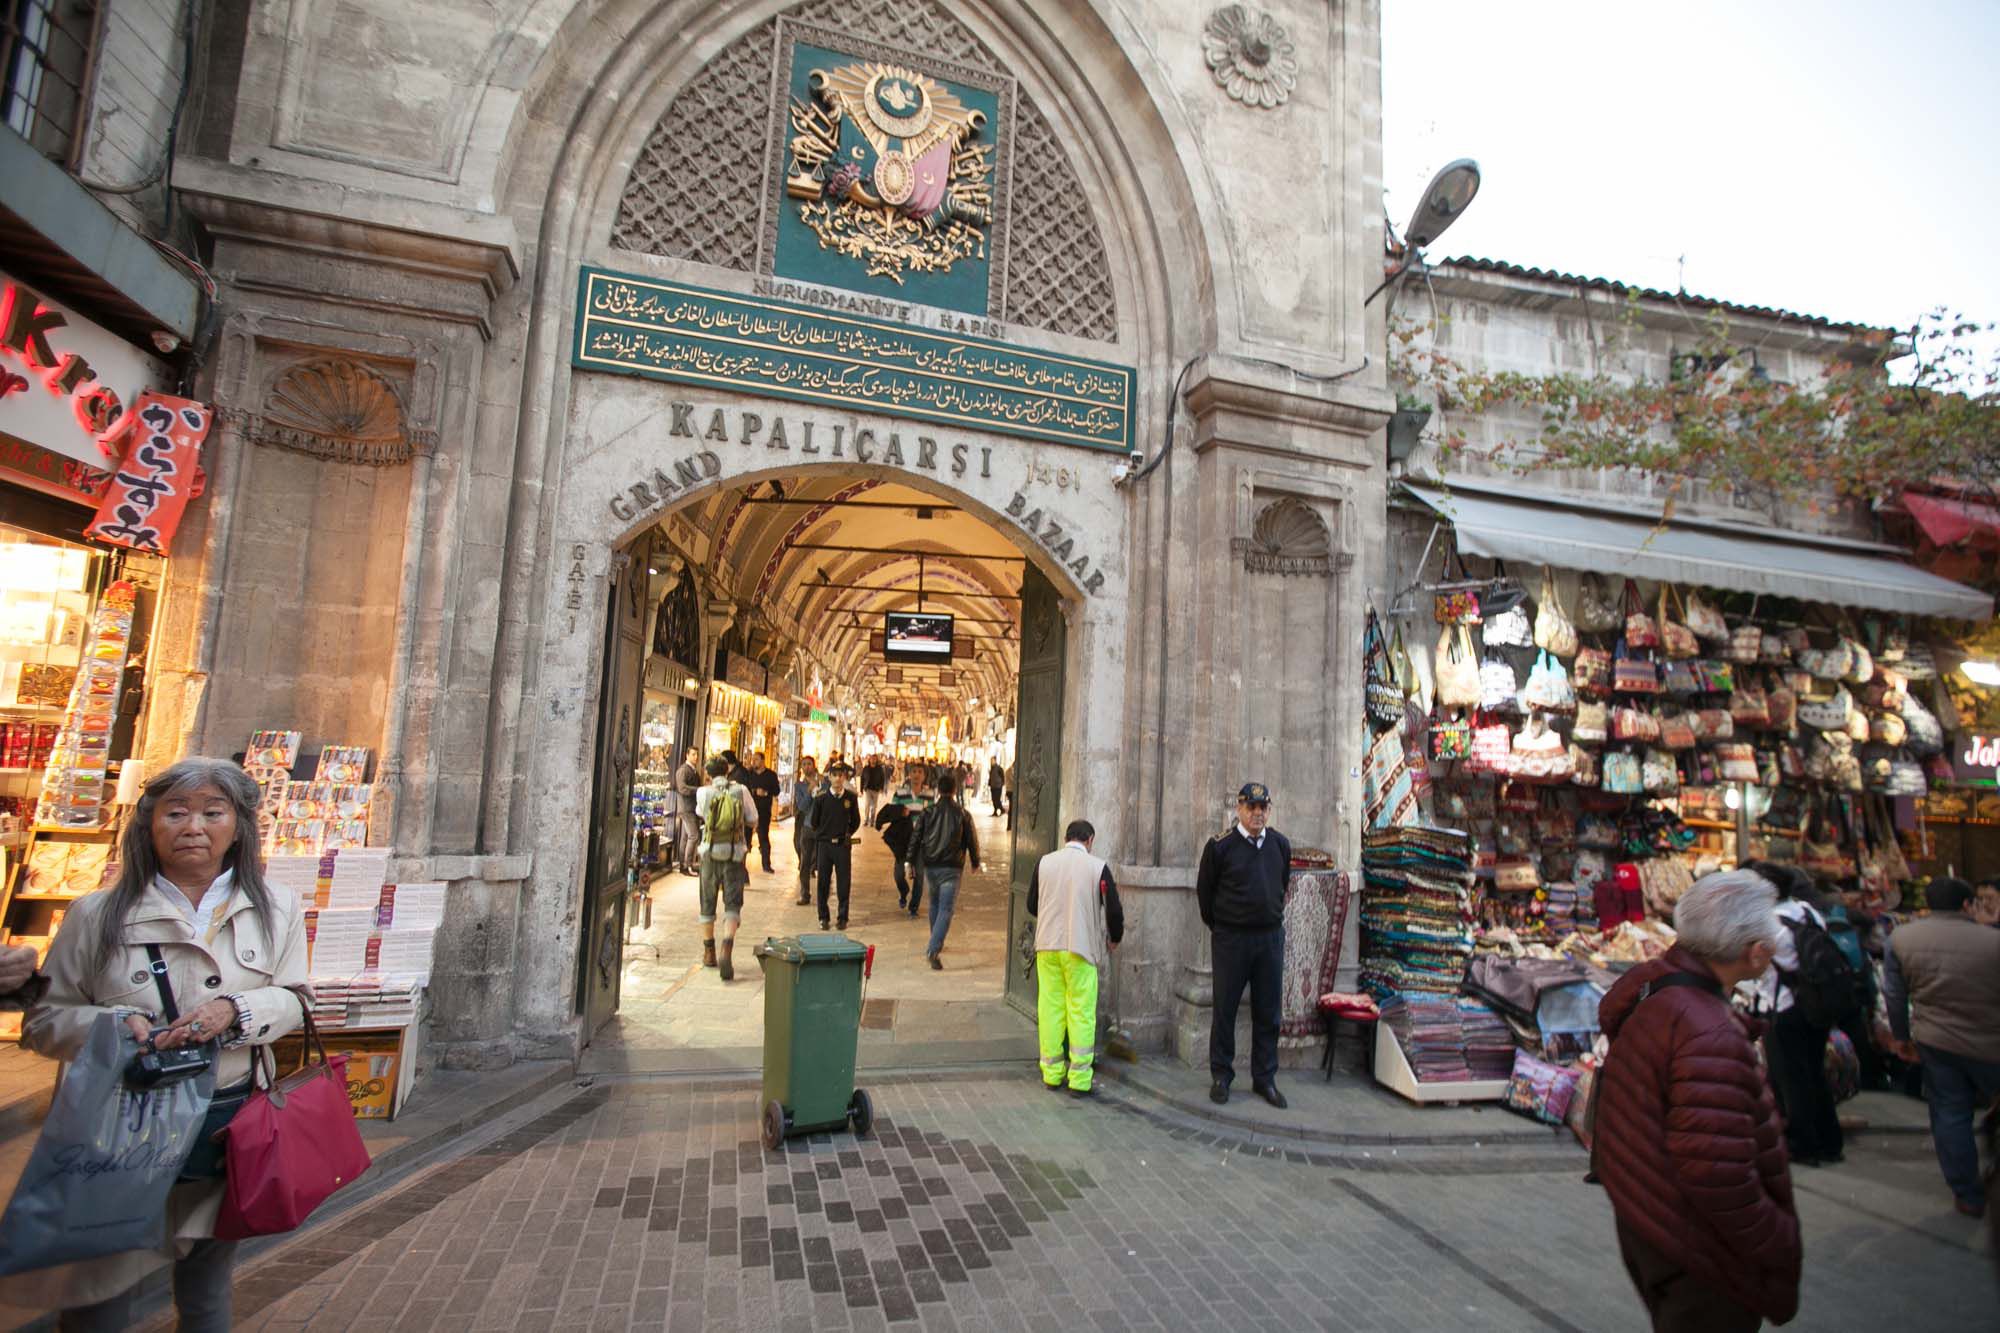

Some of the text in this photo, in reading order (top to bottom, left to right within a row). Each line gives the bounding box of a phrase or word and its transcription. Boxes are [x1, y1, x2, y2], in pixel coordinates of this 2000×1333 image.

[669, 401, 992, 478] KAPALIÇARŞI
[1026, 463, 1082, 494] 1461
[610, 449, 1106, 597] GRAND BAZAAR
